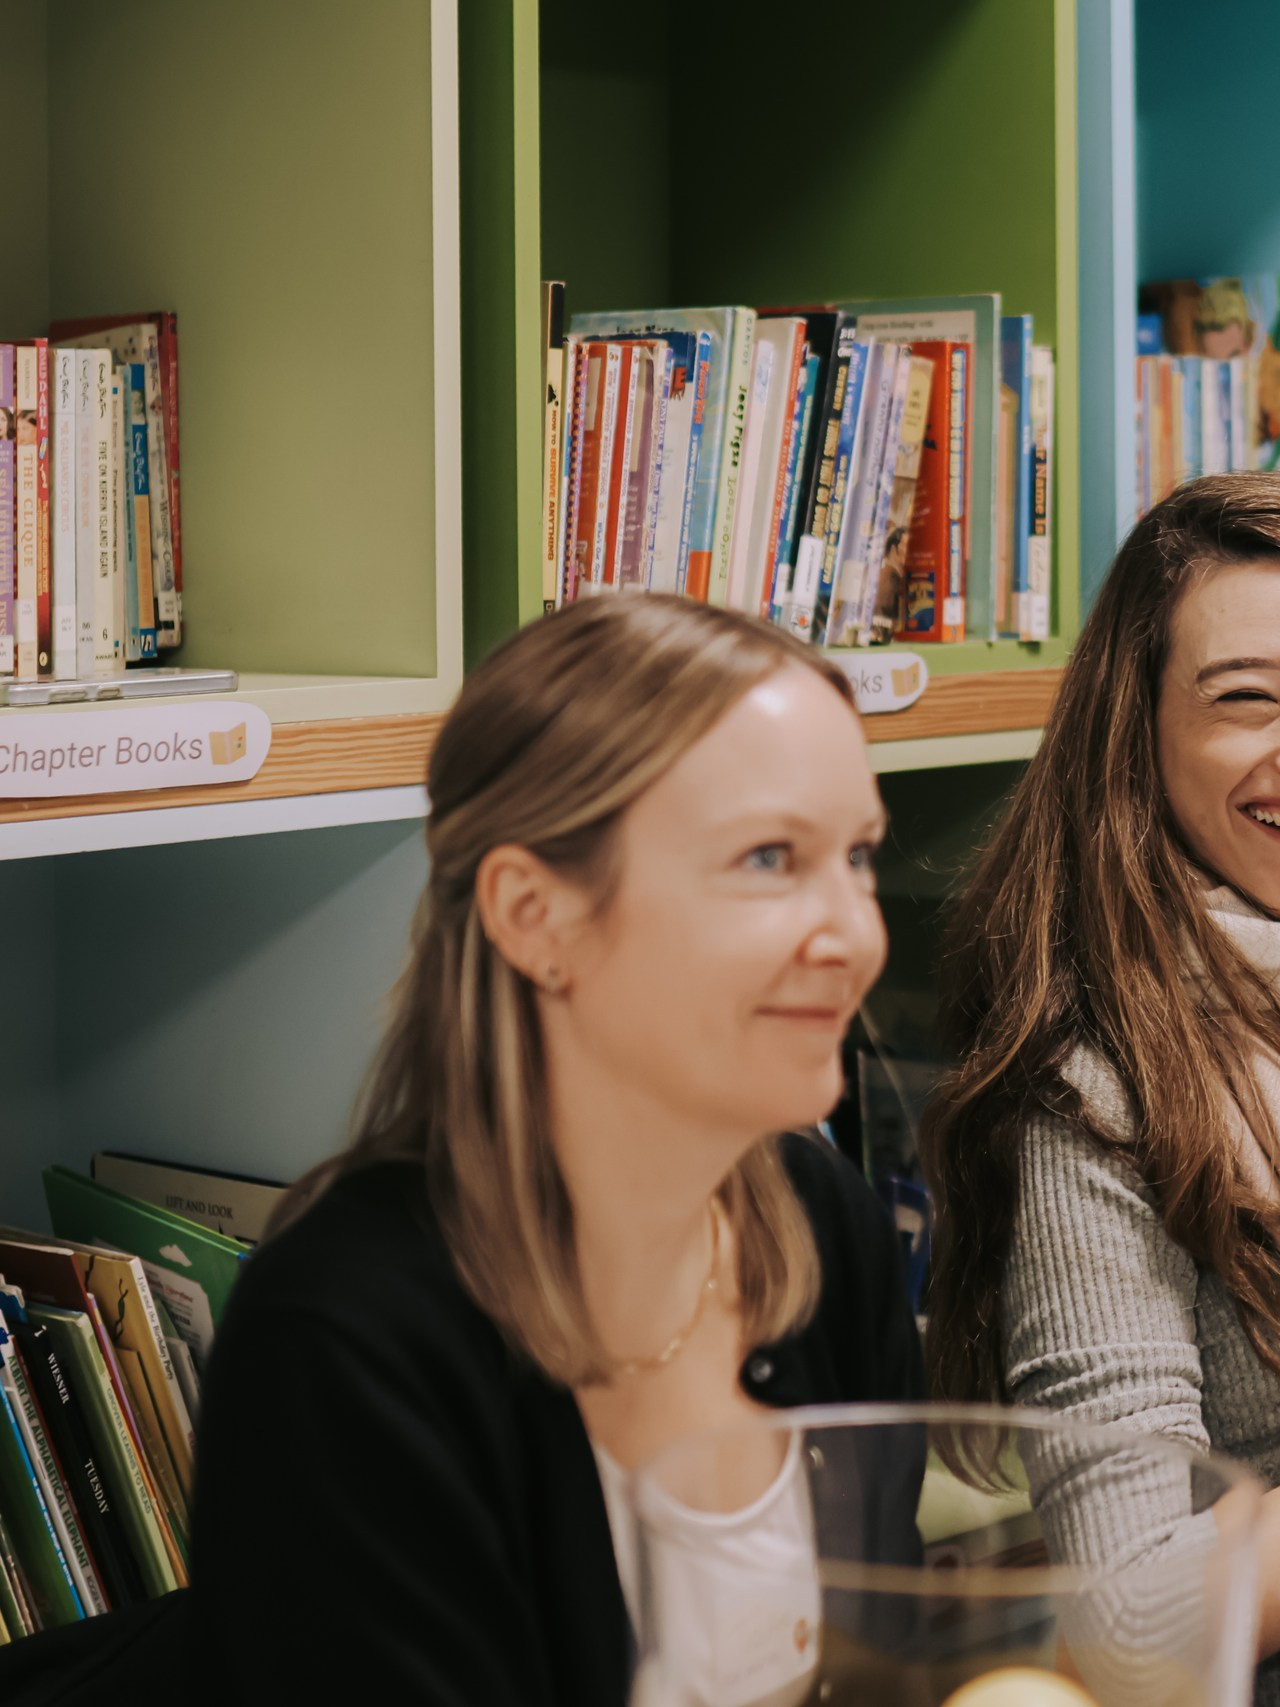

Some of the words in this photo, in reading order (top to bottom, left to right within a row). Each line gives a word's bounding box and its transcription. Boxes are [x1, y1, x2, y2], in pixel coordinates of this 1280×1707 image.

[39, 380, 48, 430] DAHL
[733, 384, 748, 421] Joey
[99, 441, 108, 461] FIVE
[551, 434, 557, 446] TO
[729, 425, 744, 468] Pigza
[23, 453, 33, 490] THE
[99, 463, 107, 477] ON
[549, 447, 557, 498] SURVIVE
[1035, 463, 1047, 514] Name
[21, 498, 34, 568] CLIQUE
[99, 515, 108, 548] ISLAND
[547, 500, 556, 561] ANYTHING
[1035, 517, 1048, 535] Is
[100, 551, 108, 578] AGAIN
[102, 628, 109, 641] 6
[0, 743, 107, 777] Chapter
[115, 732, 203, 766] Books
[186, 1200, 206, 1215] AND
[208, 1203, 235, 1220] LOOK
[143, 1295, 152, 1310] and
[153, 1325, 167, 1358] Birthday
[163, 1359, 174, 1381] Party
[47, 1353, 70, 1404] WIESNER
[8, 1356, 28, 1397] ALBERT
[22, 1400, 37, 1423] THE
[31, 1425, 67, 1508] ALPHABETICAL
[63, 1510, 90, 1569] ELEPHANT
[106, 1387, 123, 1429] GROVER
[120, 1430, 137, 1470] LEARNS
[133, 1471, 142, 1486] TO
[138, 1486, 152, 1514] READ
[85, 1458, 110, 1514] TUESDAY
